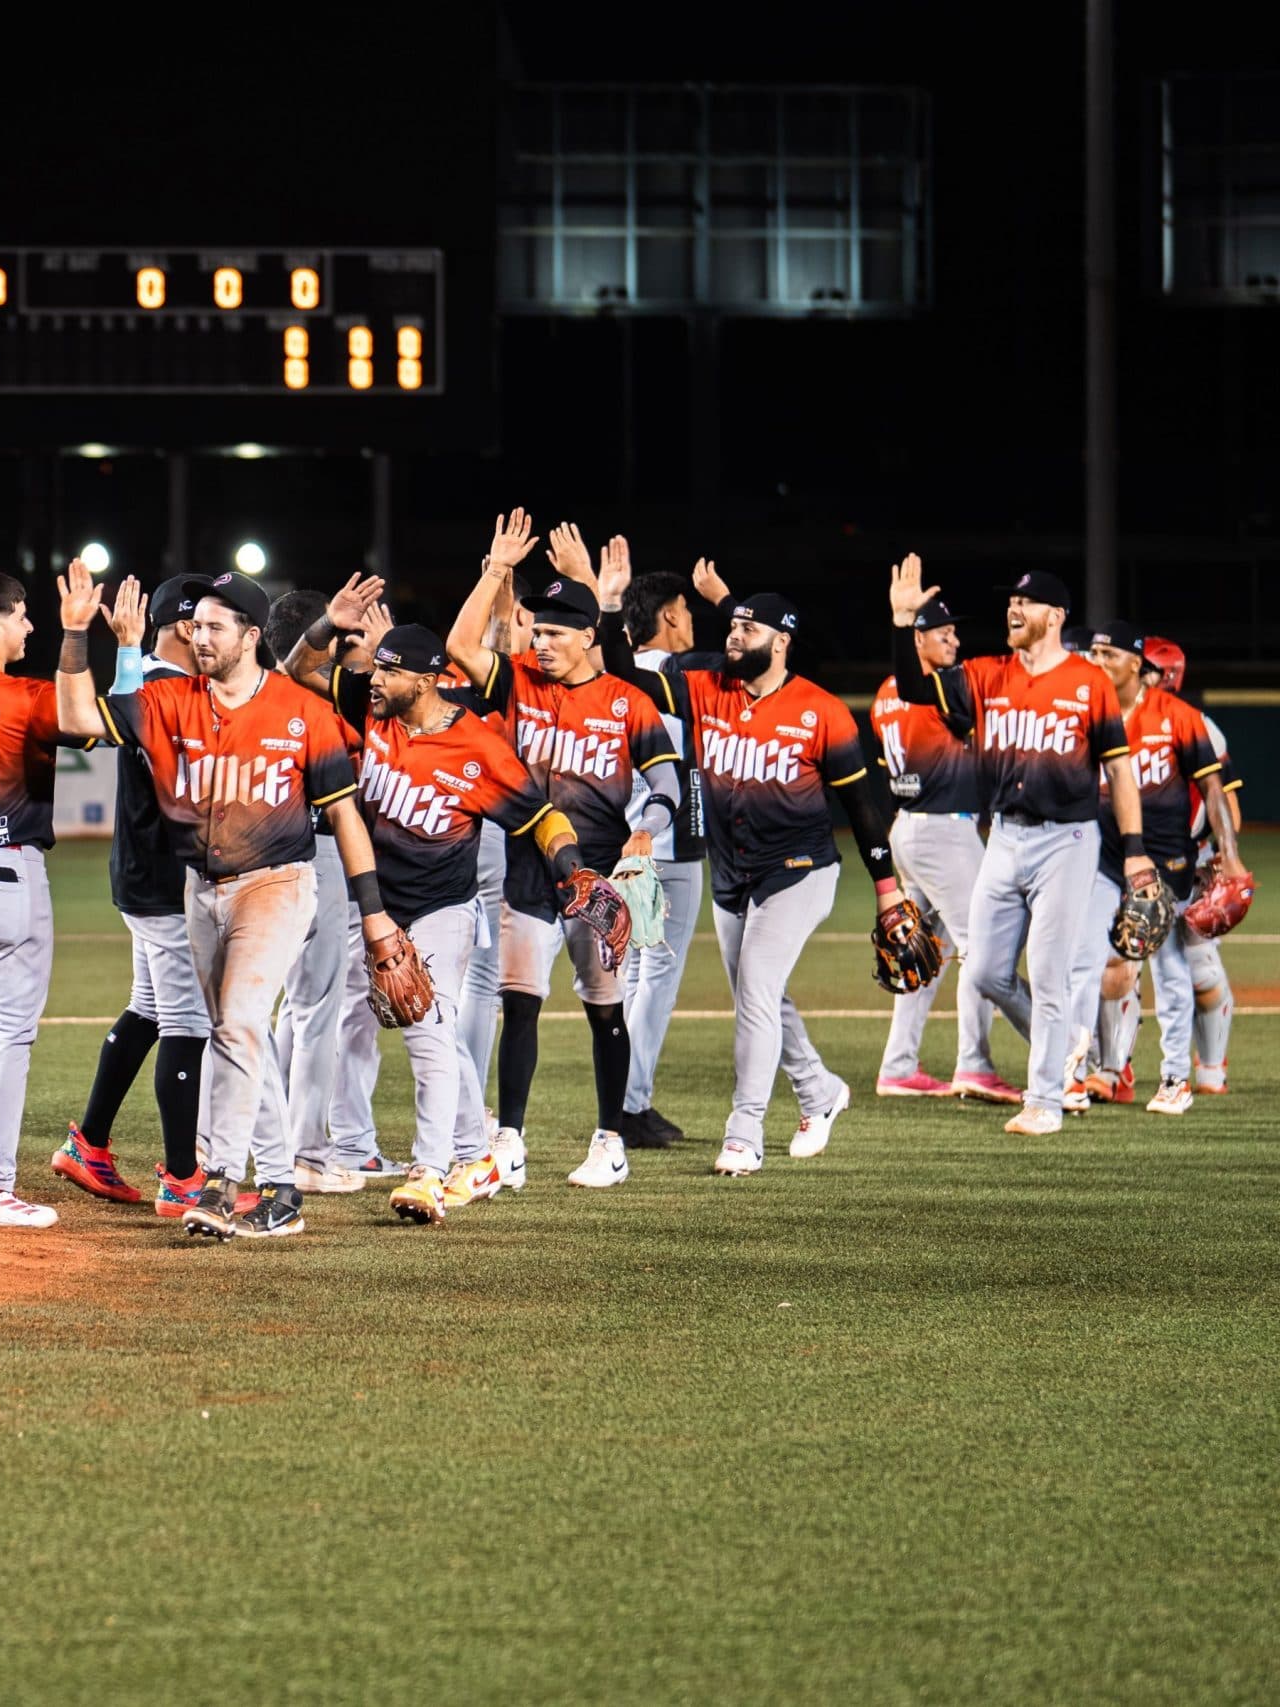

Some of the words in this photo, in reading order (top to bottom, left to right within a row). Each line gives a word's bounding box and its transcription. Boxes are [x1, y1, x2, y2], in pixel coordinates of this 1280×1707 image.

[135, 266, 167, 310] 0
[211, 266, 244, 310] 0
[289, 266, 321, 310] 0
[517, 718, 622, 780] PONCE
[702, 728, 804, 785] PONCE
[984, 708, 1080, 756] PONCE
[357, 747, 461, 836] PONCE
